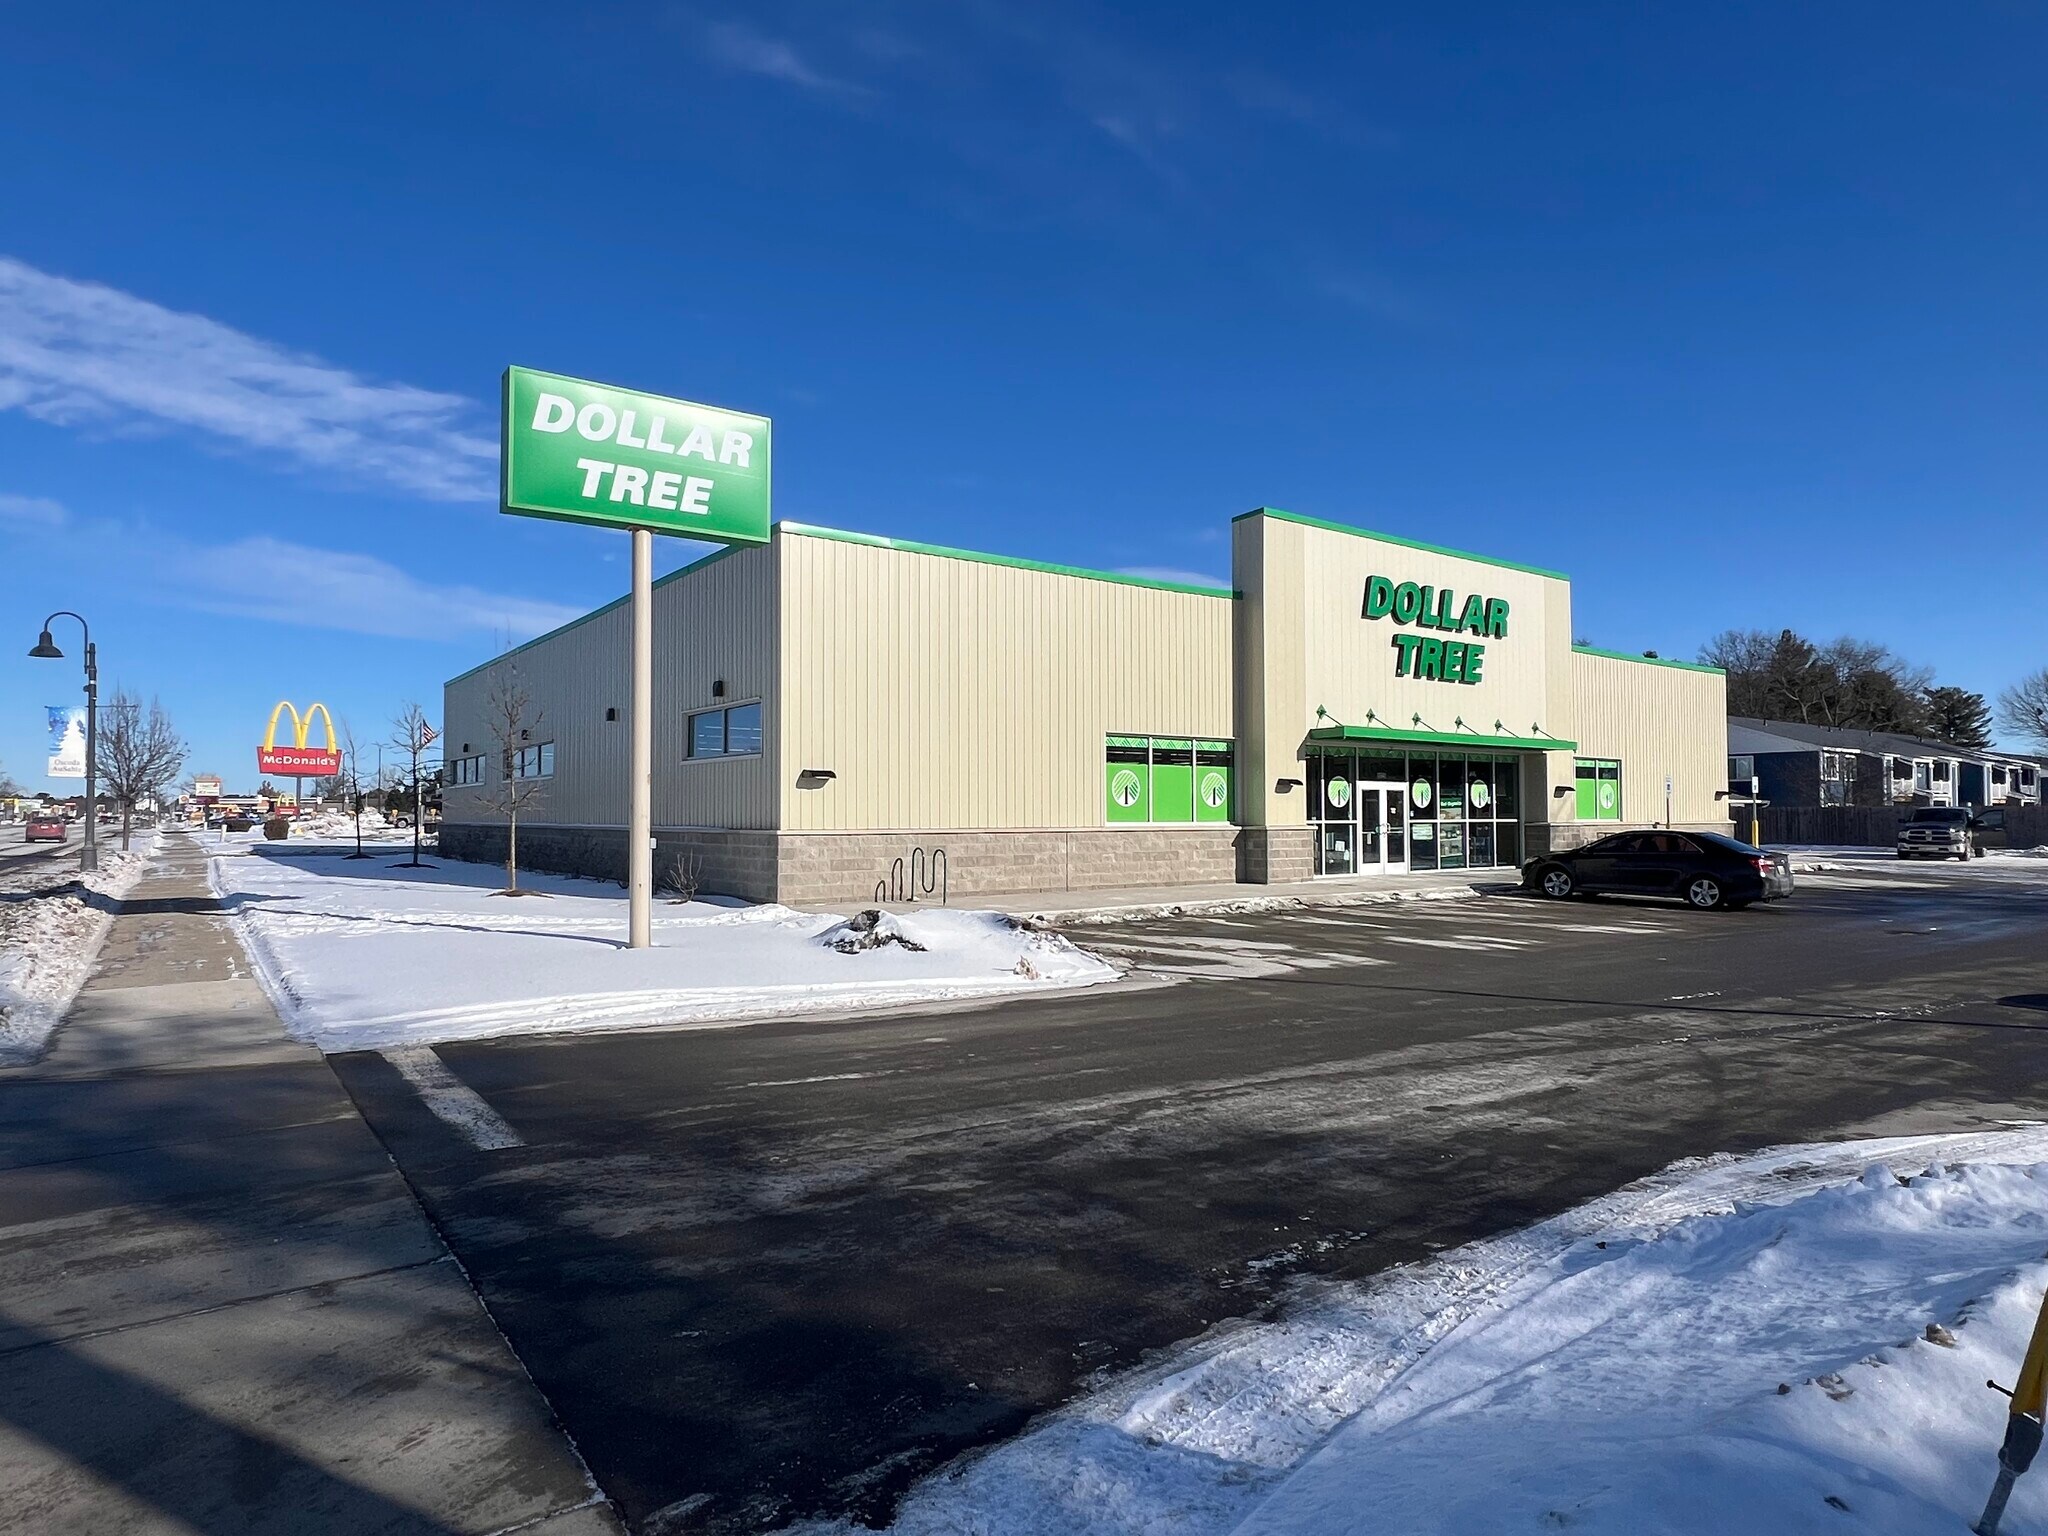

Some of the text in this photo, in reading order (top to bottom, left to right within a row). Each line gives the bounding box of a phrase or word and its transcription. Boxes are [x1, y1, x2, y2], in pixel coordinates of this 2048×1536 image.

[531, 392, 754, 469] DOLLAR
[576, 457, 715, 515] TREE
[1361, 575, 1510, 640] DOLLAR
[1391, 633, 1486, 686] TREE
[262, 755, 337, 767] McDonald's
